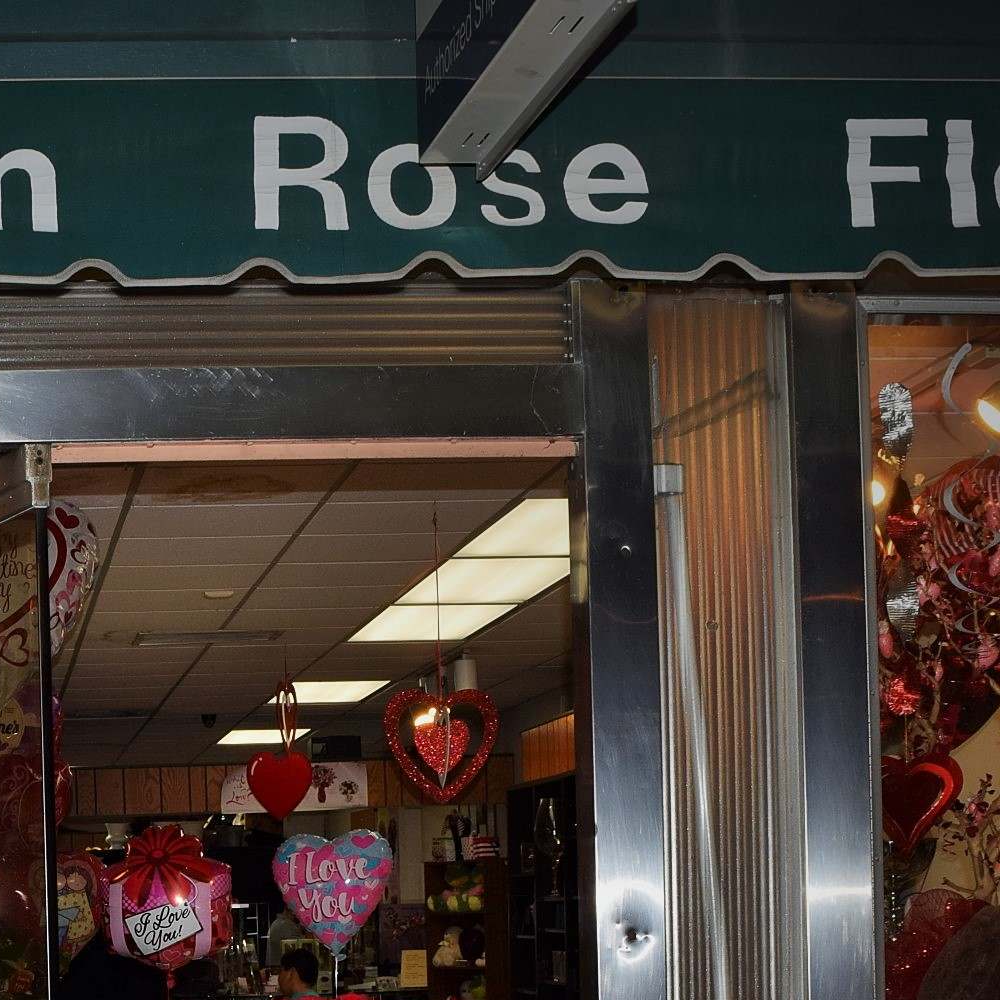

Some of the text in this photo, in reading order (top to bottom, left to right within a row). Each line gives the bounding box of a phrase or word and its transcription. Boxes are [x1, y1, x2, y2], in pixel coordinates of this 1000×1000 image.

[424, 1, 472, 104] Authorized
[253, 115, 650, 231] Rose
[846, 117, 1000, 228] Fl
[288, 850, 371, 886] I Love
[134, 905, 191, 937] I Love
[144, 924, 183, 951] You!
